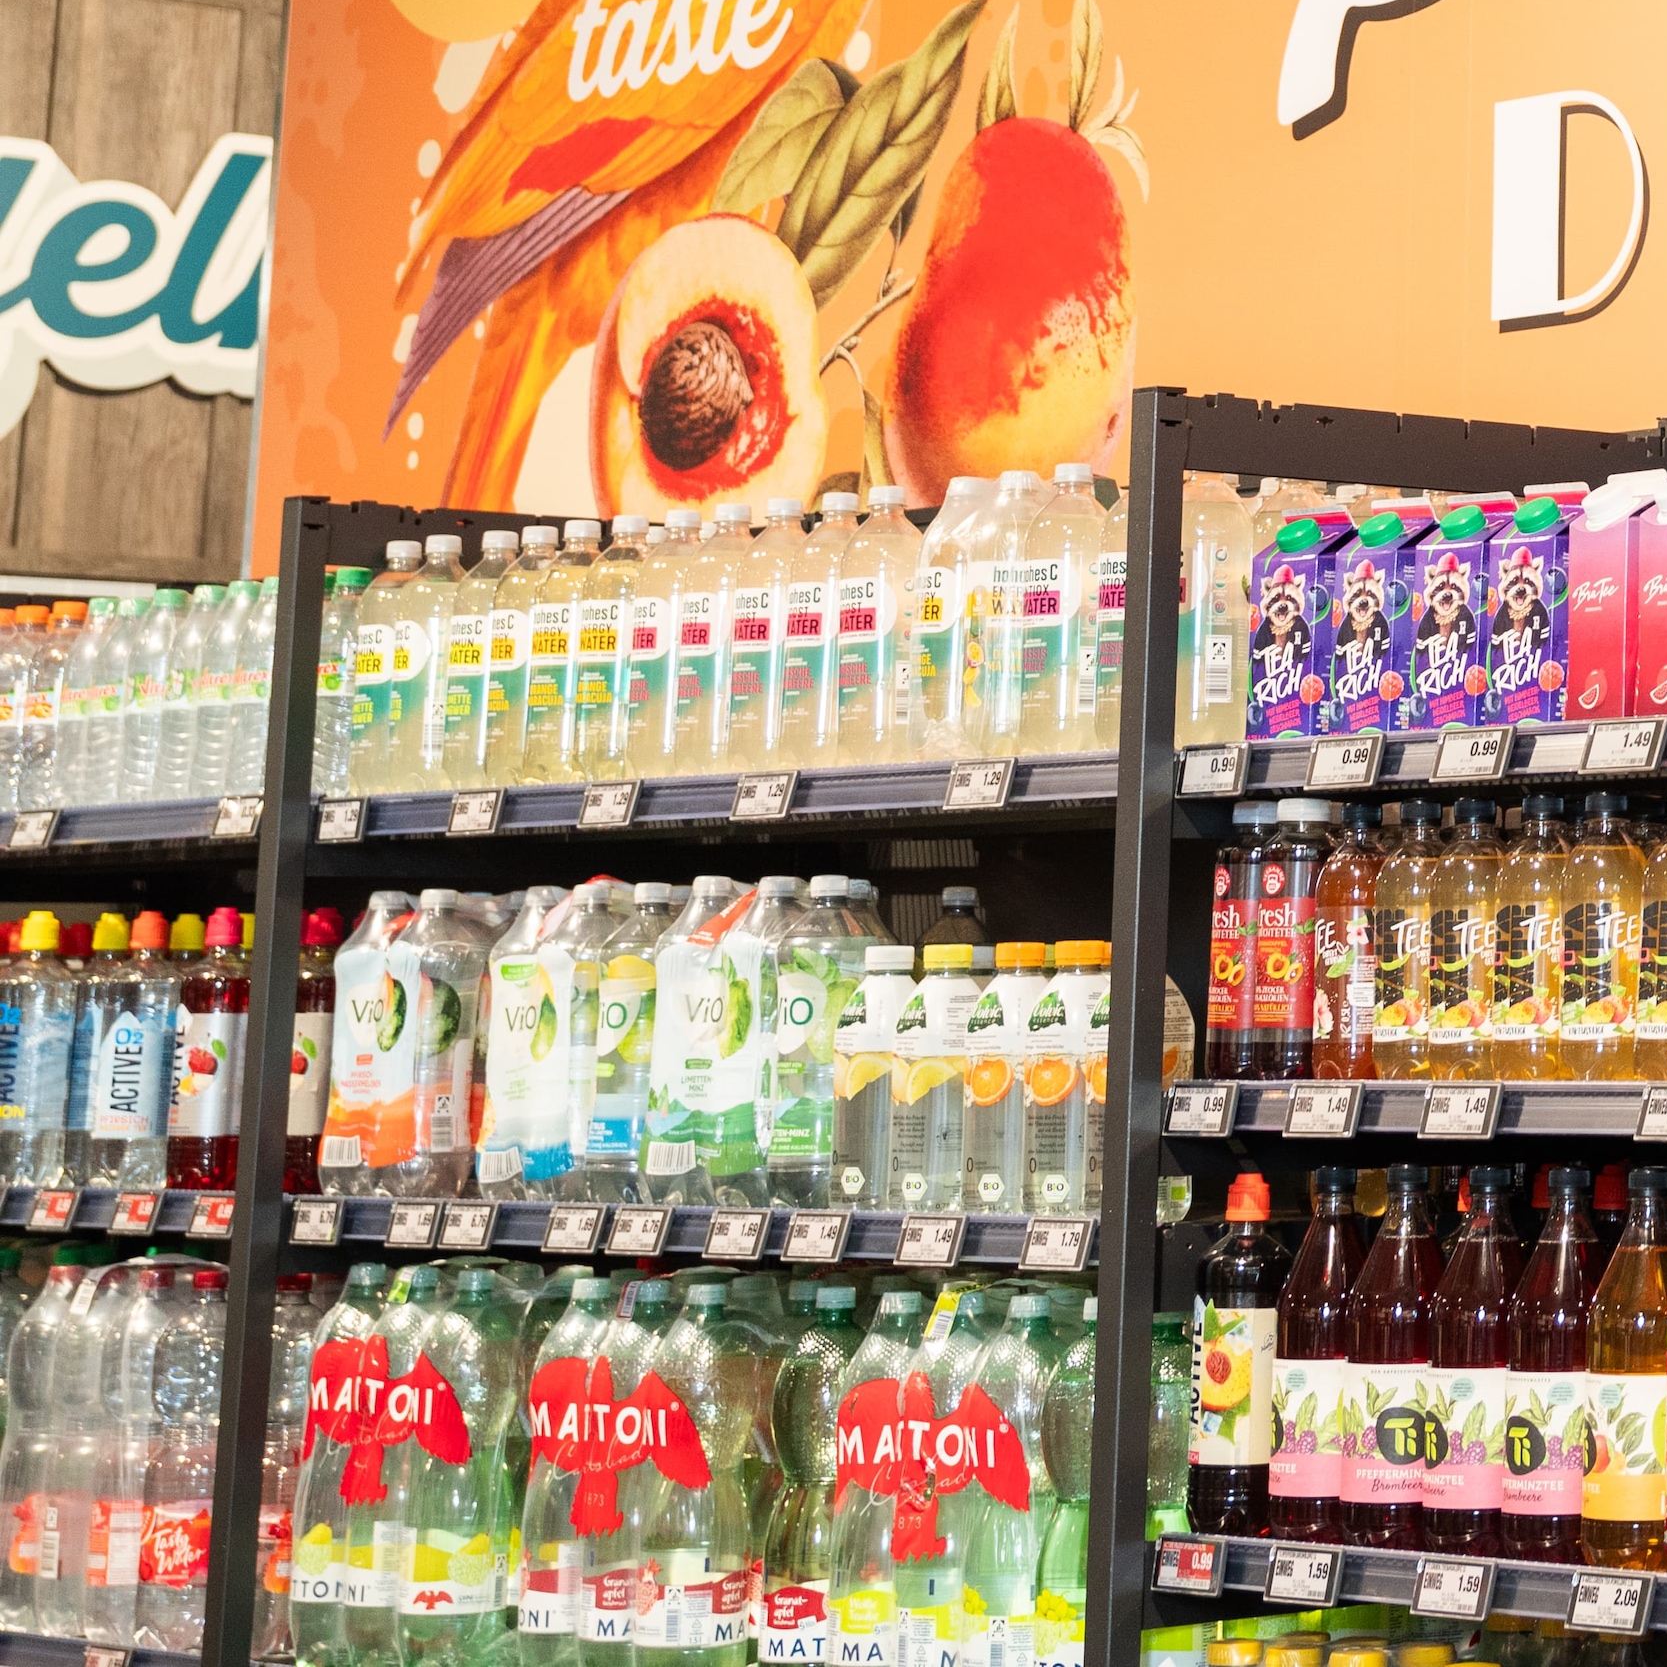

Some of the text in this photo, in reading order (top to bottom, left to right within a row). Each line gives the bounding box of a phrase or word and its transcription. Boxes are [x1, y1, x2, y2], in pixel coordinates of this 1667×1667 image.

[1339, 638, 1375, 673] TEA
[1418, 633, 1456, 668] TEA
[1493, 627, 1533, 664] TEA
[1260, 642, 1295, 674] TEA
[1335, 658, 1381, 702] RICH
[1416, 652, 1468, 698] RICH
[1491, 648, 1542, 694] RICH
[1253, 663, 1303, 707] RICH
[1470, 740, 1498, 758] 0.99
[1622, 730, 1651, 748] 1.49
[1210, 755, 1236, 774] 0.99
[1342, 748, 1368, 765] 0.99
[983, 771, 1001, 786] 1.29
[1390, 917, 1430, 960] TEE
[1452, 917, 1495, 960] TEE
[1519, 913, 1561, 956] TEE
[1595, 911, 1639, 955] TEE
[110, 1045, 143, 1114] ACTIVE
[1203, 1096, 1223, 1112] 0.99
[1327, 1097, 1349, 1113] 1.49
[1464, 1097, 1486, 1116] 1.49
[934, 1228, 953, 1244] 1.49
[1060, 1232, 1081, 1248] 1.79
[151, 1526, 189, 1555] Tasty
[1191, 1552, 1212, 1571] 0.99
[1307, 1562, 1330, 1580] 1.59
[1458, 1576, 1481, 1594] 1.59
[1614, 1588, 1638, 1607] 2.09
